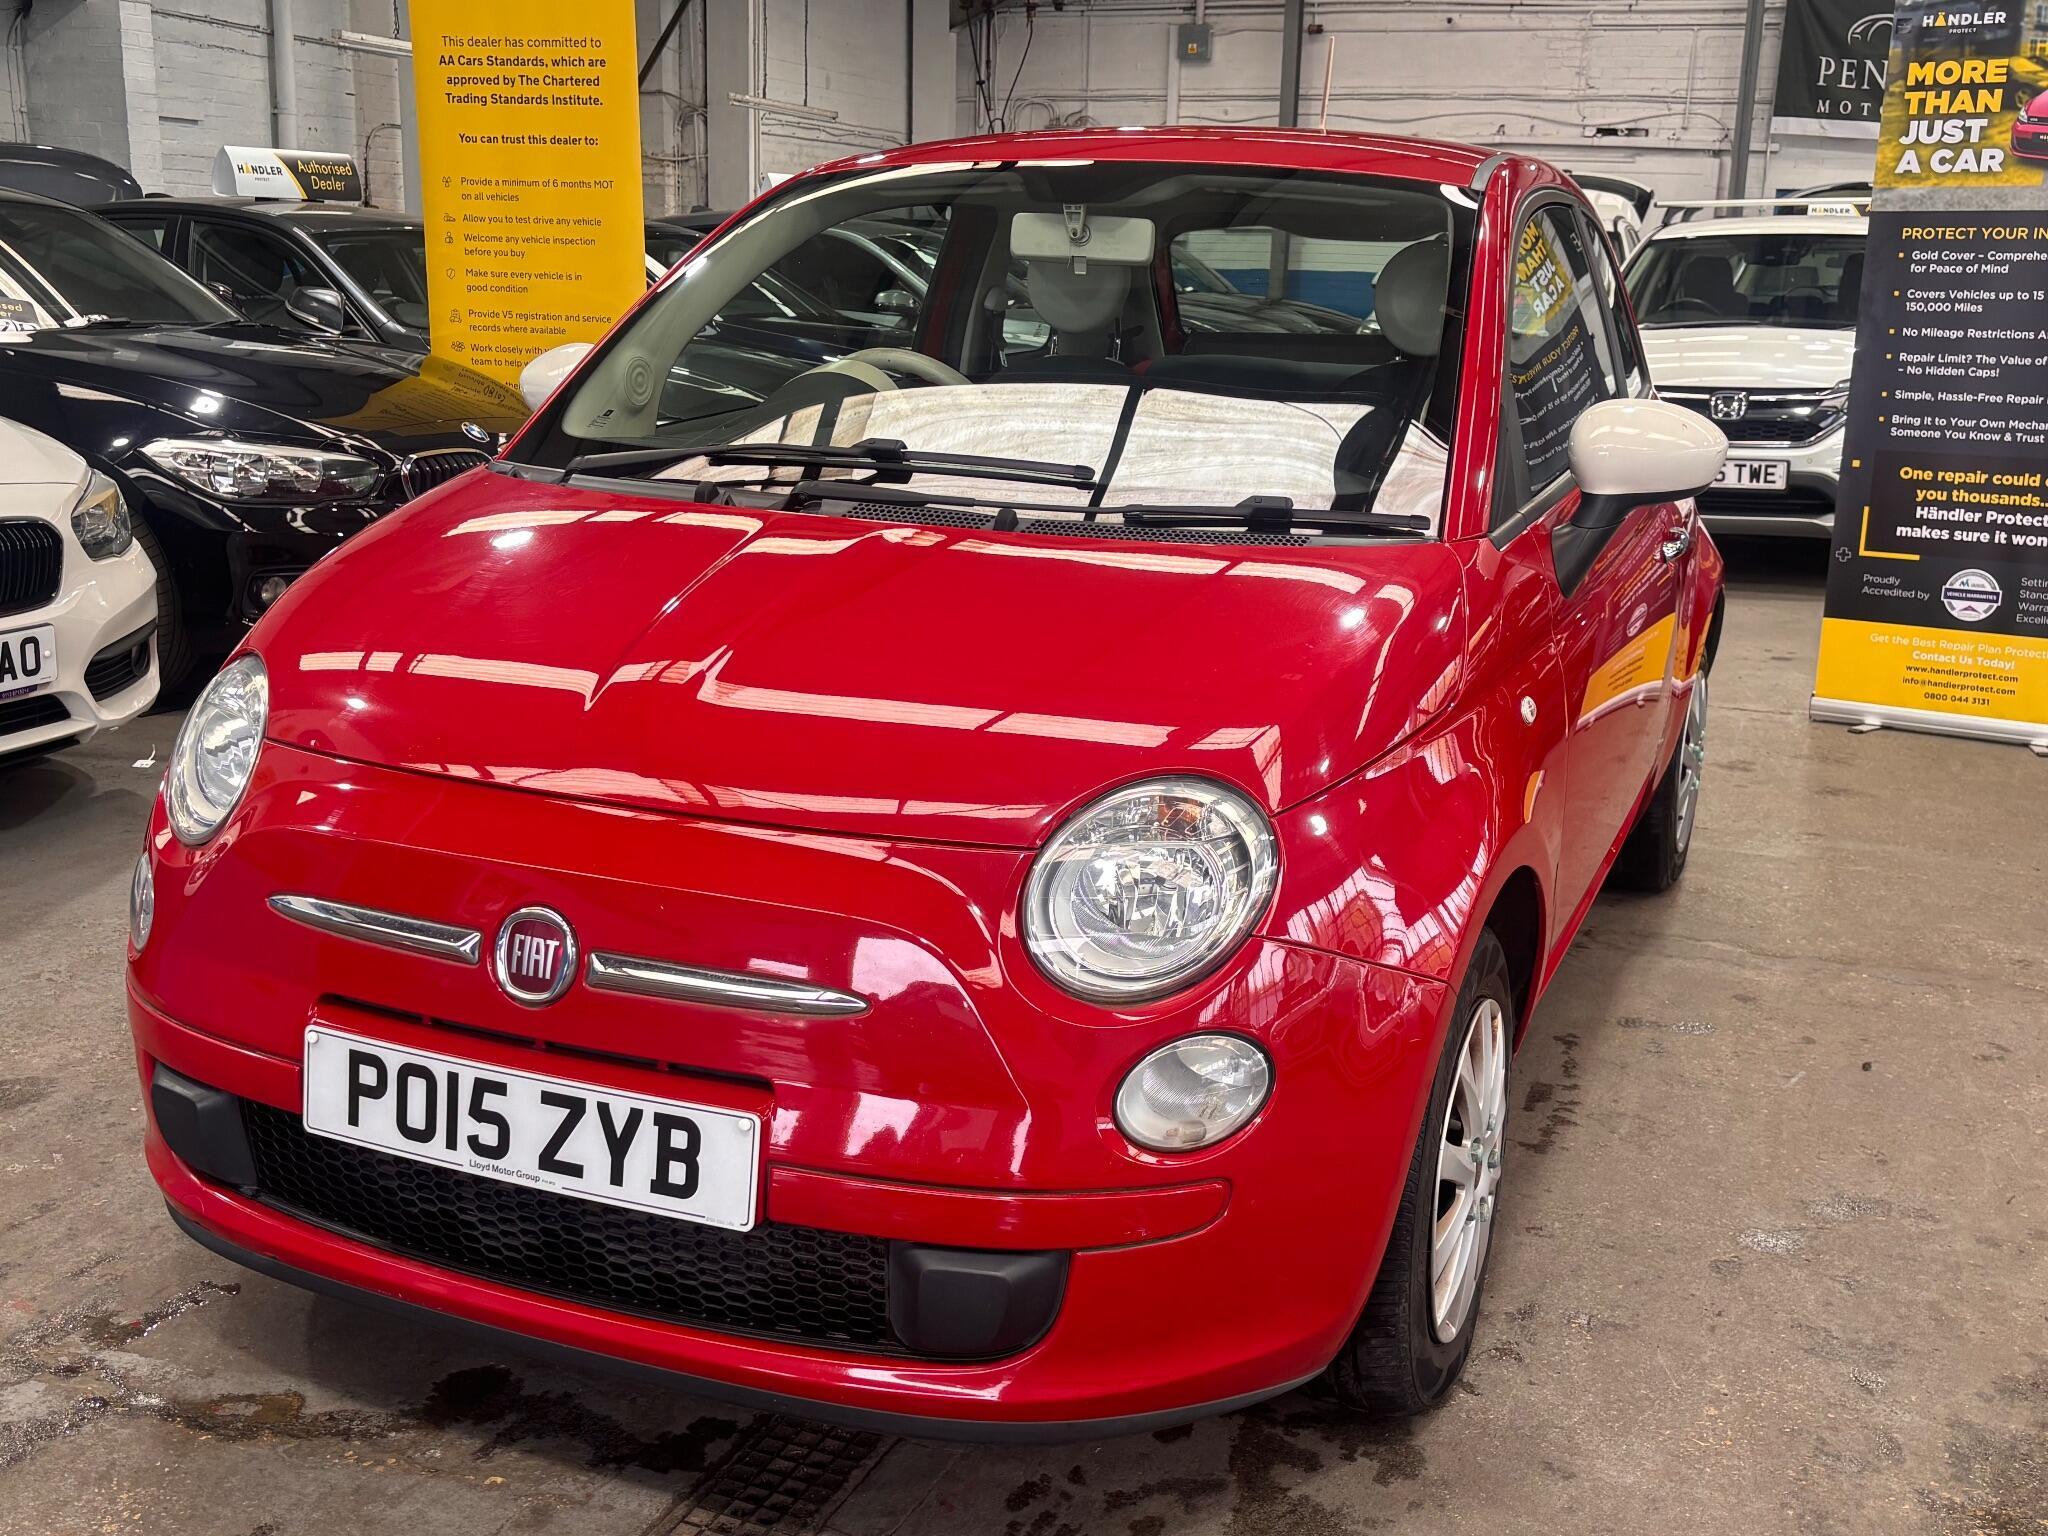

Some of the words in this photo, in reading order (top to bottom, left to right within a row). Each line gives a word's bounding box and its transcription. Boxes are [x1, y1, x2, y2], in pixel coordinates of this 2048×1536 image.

[441, 35, 465, 47] This
[467, 36, 502, 48] dealer
[504, 37, 524, 48] has
[527, 37, 587, 49] committed
[590, 38, 601, 49] to
[439, 55, 455, 66] AA
[458, 56, 483, 66] Cars
[486, 56, 549, 68] Standards,
[551, 56, 585, 67] which
[588, 58, 606, 68] are
[1906, 59, 2009, 86] MORE
[446, 75, 500, 88] approved
[503, 75, 516, 88] by
[518, 75, 540, 86] The
[542, 75, 600, 86] Chartered
[445, 93, 488, 106] Trading
[490, 94, 549, 105] Standards
[552, 94, 603, 106] Institute.
[1904, 89, 2003, 115] THAN
[1817, 99, 1883, 116] MOT
[1899, 118, 1988, 145] JUST
[459, 133, 478, 144] You
[480, 136, 499, 144] can
[501, 135, 525, 144] trust
[528, 134, 547, 145] this
[550, 135, 582, 145] dealer
[584, 137, 599, 146] to:
[297, 160, 353, 176] Authorised
[1894, 150, 1921, 174] A
[1930, 148, 2004, 173] CAR
[311, 176, 345, 190] Dealer
[461, 177, 493, 187] Provide
[495, 179, 500, 187] a
[502, 178, 540, 187] minimum
[542, 179, 551, 188] of
[552, 179, 558, 188] 6
[560, 179, 592, 189] months
[594, 180, 614, 189] MOT
[462, 214, 486, 223] Allow
[487, 217, 503, 225] you
[504, 216, 513, 224] to
[515, 216, 531, 224] test
[533, 216, 554, 225] drive
[556, 218, 570, 226] any
[572, 217, 601, 226] vehicle
[464, 233, 503, 243] Welcome
[505, 236, 520, 245] any
[521, 235, 551, 244] vehicle
[552, 236, 595, 246] inspection
[1902, 228, 1977, 240] PROTECT
[1982, 228, 2028, 240] YOUR
[1912, 251, 1938, 260] Gold
[1942, 252, 1975, 261] Cover
[465, 269, 488, 278] Make
[510, 271, 532, 281] every
[534, 271, 563, 280] vehicle
[566, 272, 573, 280] is
[574, 272, 582, 280] in
[1907, 289, 1946, 299] Covers
[1948, 290, 1997, 300] Vehicles
[1999, 292, 2014, 301] up
[2017, 292, 2030, 300] to
[2033, 291, 2044, 300] 15
[468, 310, 500, 319] Provide
[502, 311, 513, 319] V5
[515, 312, 562, 322] registration
[564, 314, 580, 322] and
[582, 315, 612, 323] service
[469, 324, 500, 333] records
[503, 325, 528, 334] where
[530, 326, 566, 335] available
[1902, 328, 1918, 337] No
[1921, 328, 1964, 339] Mileage
[1967, 329, 2034, 339] Restrictions
[470, 344, 493, 352] Work
[495, 344, 522, 355] closely
[471, 358, 492, 366] team
[494, 358, 502, 366] to
[504, 357, 523, 368] help
[1899, 353, 1935, 364] Repair
[1938, 354, 1972, 364] Limit?
[1975, 355, 1996, 364] The
[2000, 356, 2032, 365] Value
[2035, 356, 2047, 366] of
[1906, 366, 1922, 375] No
[1925, 367, 1965, 376] Hidden
[1968, 367, 2000, 378] Caps!
[1894, 390, 1934, 402] Simple,
[1937, 392, 2003, 403] Hassle-Free
[2006, 393, 2044, 405] Repair
[1891, 415, 1921, 426] Bring
[1935, 417, 1947, 426] to
[1950, 417, 1977, 428] Your
[1979, 418, 2005, 429] Own
[1890, 427, 1941, 438] Someone
[1944, 429, 1966, 439] You
[1969, 431, 2001, 441] Know
[2004, 432, 2012, 442] &
[2015, 433, 2045, 443] Trust
[1734, 463, 1777, 484] TWE
[1900, 466, 1933, 481] One
[1937, 470, 1988, 486] repair
[1992, 473, 2041, 487] could
[1915, 489, 1947, 503] you
[1915, 506, 1982, 523] Händler
[1986, 511, 2048, 527] Protect
[1896, 524, 1949, 540] makes
[1953, 529, 1990, 543] sure
[1994, 531, 2007, 544] it
[1863, 574, 1901, 586] Proudly
[1861, 586, 1915, 598] Accredited
[1917, 590, 1929, 601] by
[1870, 633, 1889, 643] Get
[1892, 635, 1909, 645] the
[1913, 637, 1936, 648] Best
[1939, 639, 1974, 653] Repair
[1978, 643, 2001, 654] Plan
[1913, 650, 1956, 663] Contact
[1959, 655, 1973, 665] Us
[1977, 657, 2015, 670] Today!
[1906, 665, 2018, 683] www.handlerprotect.com
[1924, 692, 1948, 701] 0800
[1950, 695, 1969, 704] 044
[1972, 697, 1990, 706] 3131
[511, 933, 559, 980] FIAT
[538, 1091, 701, 1200] ZYB
[469, 1159, 490, 1172] Lloyd
[492, 1164, 515, 1177] Motor
[516, 1170, 540, 1183] Group
